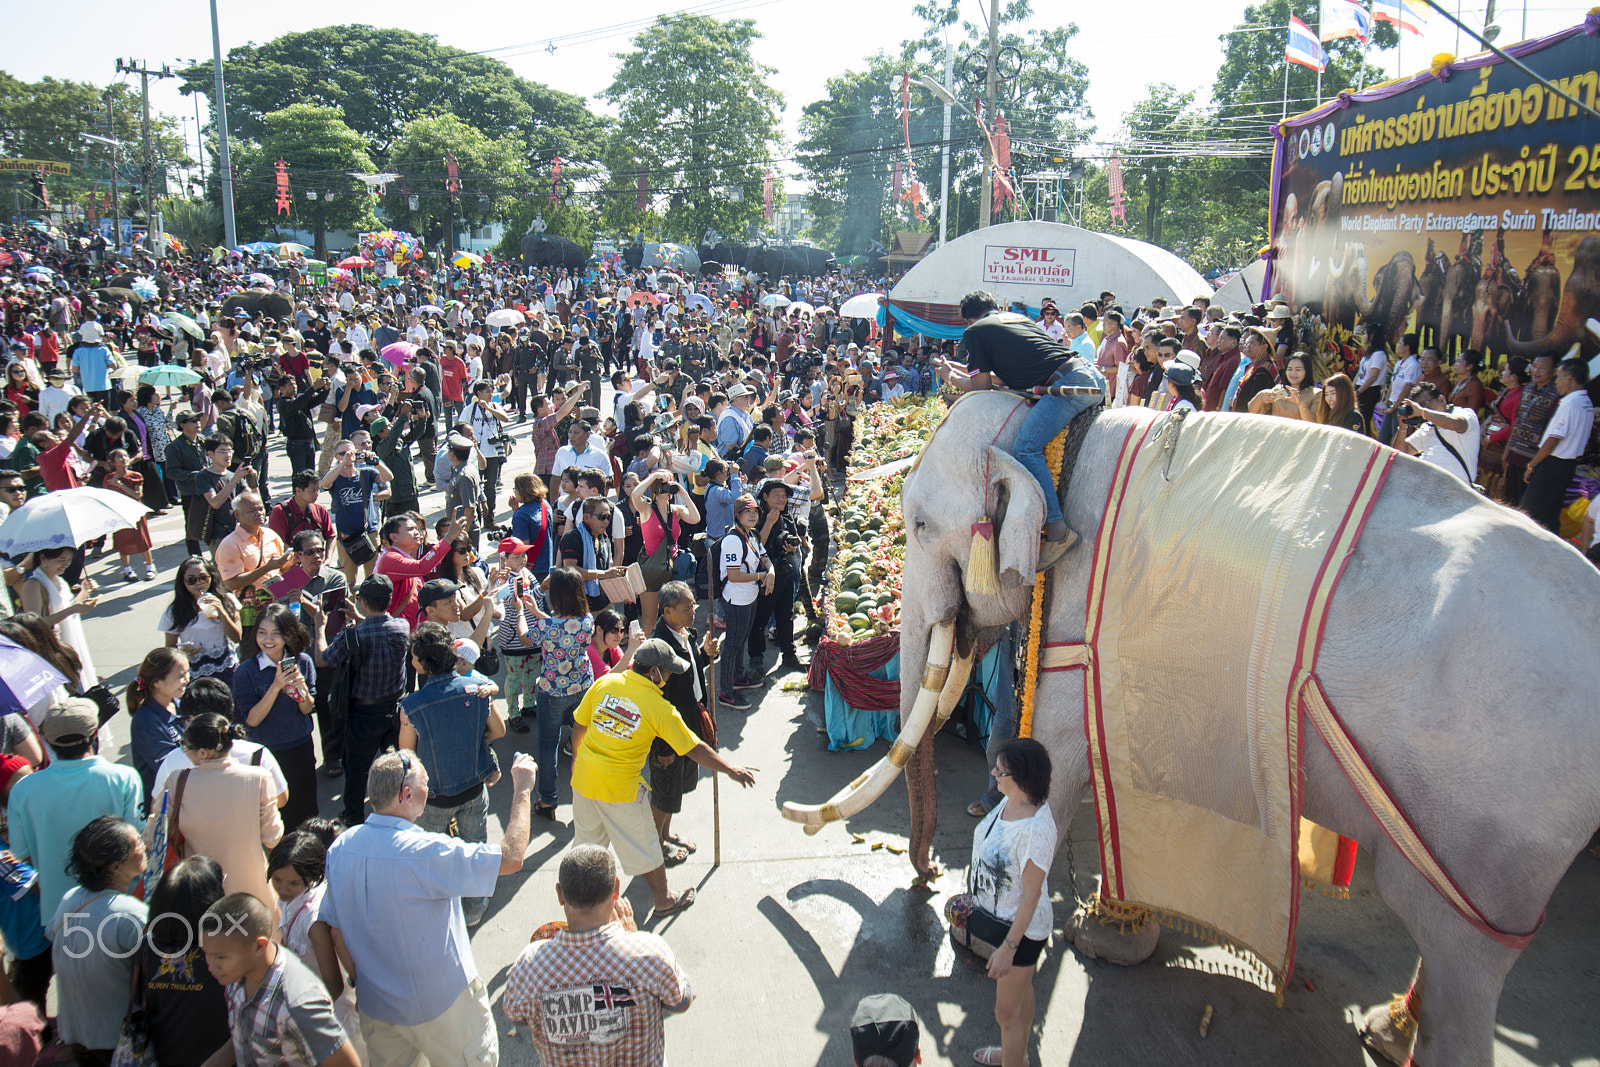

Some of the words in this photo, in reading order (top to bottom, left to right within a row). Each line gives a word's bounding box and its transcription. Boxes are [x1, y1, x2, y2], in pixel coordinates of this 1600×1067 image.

[1340, 65, 1600, 157] มหัศจรรย์งานเลี้ยงอาหา
[1341, 159, 1464, 210] ที่ยิ่งใหญ่ของโลก
[1471, 143, 1558, 197] ประจำปี
[1341, 215, 1363, 231] World
[1363, 214, 1397, 234] Elephant
[1399, 212, 1424, 234] Party
[1426, 211, 1498, 233] Extravaganza
[1502, 208, 1536, 230] Surin
[1003, 248, 1056, 262] SML
[725, 553, 737, 562] 58
[147, 981, 169, 990] SURIN
[170, 982, 204, 992] THAILAND
[545, 993, 593, 1016] CAMP
[545, 1013, 597, 1034] DAVID
